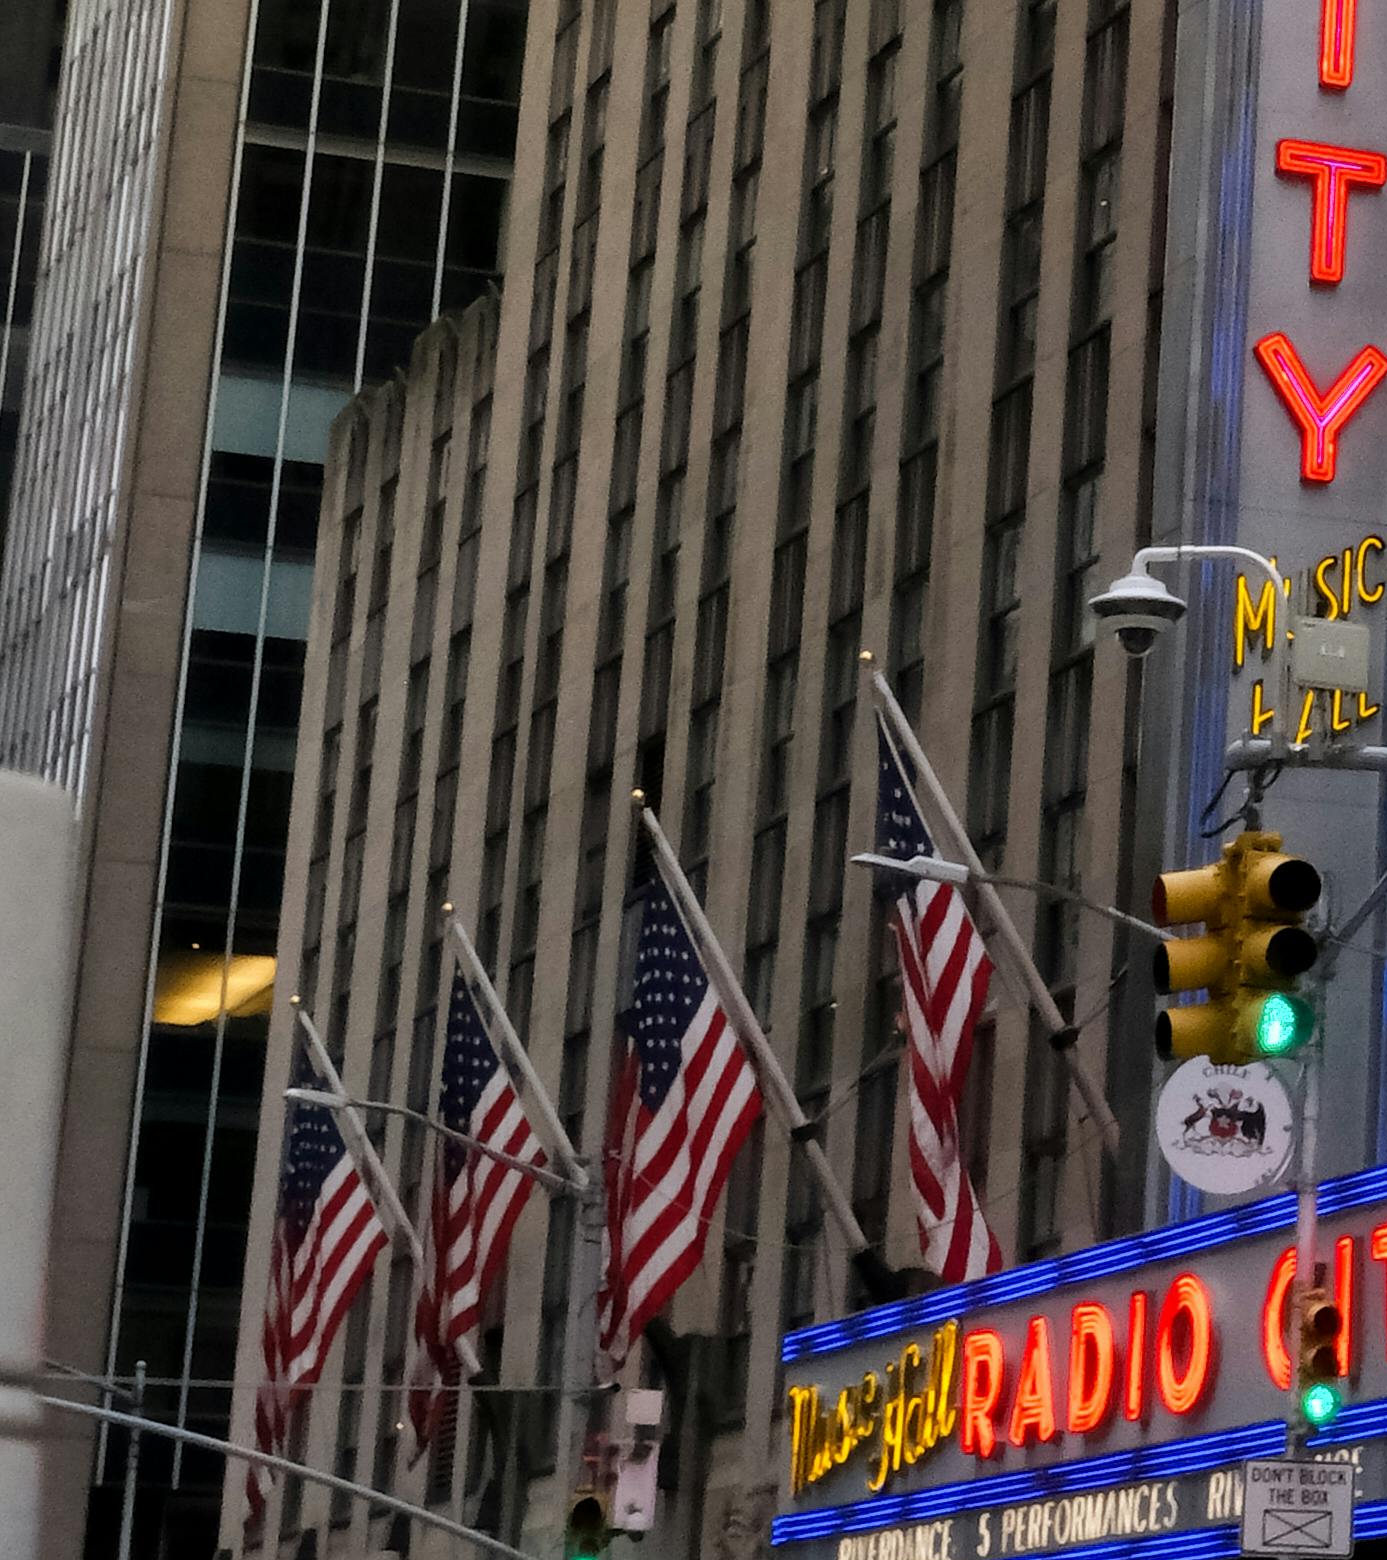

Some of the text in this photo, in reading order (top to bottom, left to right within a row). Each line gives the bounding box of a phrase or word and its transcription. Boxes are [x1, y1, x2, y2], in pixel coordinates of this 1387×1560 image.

[1234, 536, 1384, 668] MSIC
[959, 1270, 1214, 1459] RADIO
[1251, 1466, 1347, 1486] DON'T BLOCK
[1269, 1488, 1328, 1506] THE BOX
[976, 1512, 992, 1559] 5
[1001, 1480, 1180, 1553] PERFORMANCES
